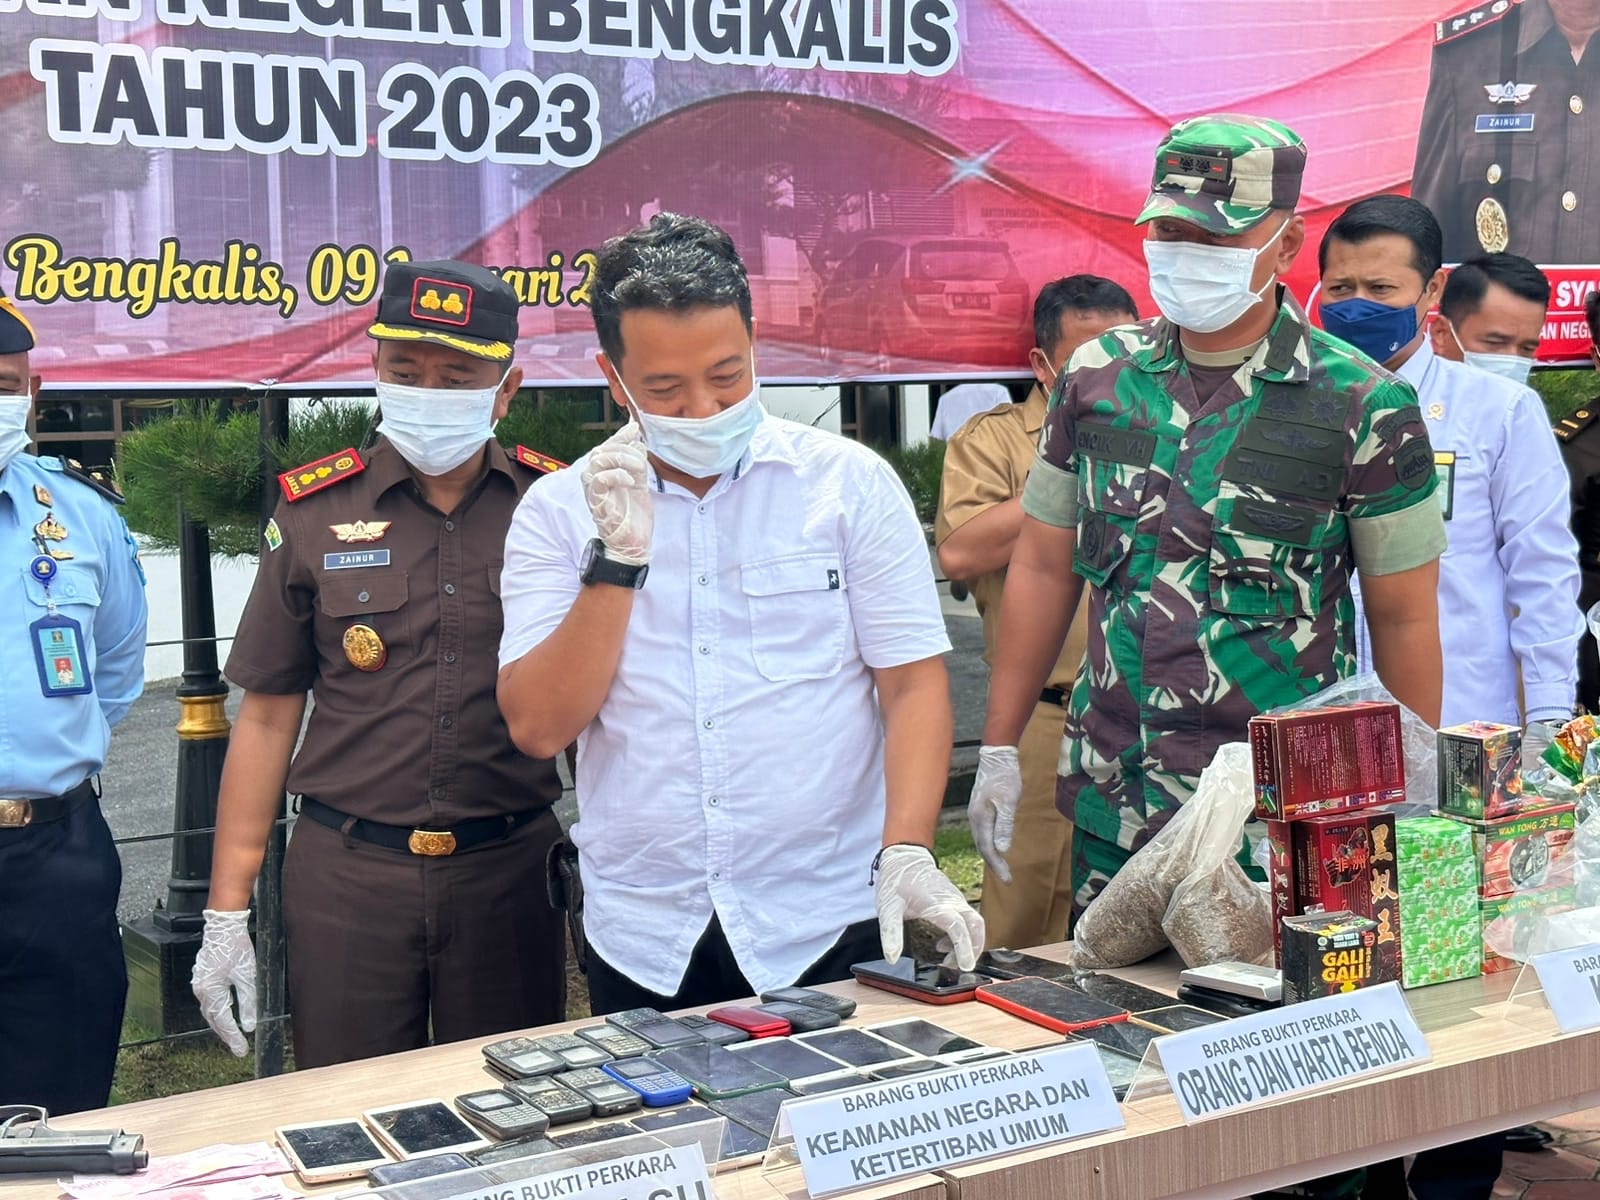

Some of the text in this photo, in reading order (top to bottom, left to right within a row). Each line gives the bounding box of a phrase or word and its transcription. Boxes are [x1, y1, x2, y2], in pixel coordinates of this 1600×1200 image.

[533, 0, 951, 67] BENGKALIS
[42, 50, 592, 157] TAHUN 2023
[1489, 118, 1520, 126] ZAINUR
[7, 237, 295, 315] Bengkalis,
[310, 247, 377, 302] 09
[1560, 321, 1592, 339] NEG
[340, 554, 374, 564] ZAINUR
[1321, 964, 1364, 982] GALI
[1322, 948, 1364, 967] GALI
[1202, 1007, 1362, 1059] BARANG BUKTI PERKARA
[842, 1058, 1044, 1113] BARANG BUKTI PERKARA
[1177, 1019, 1414, 1116] ORANG DAN HARTA BENDA
[806, 1078, 1090, 1158] KEAMANAN NEGARA DAN
[850, 1112, 1070, 1181] KETERTIBAN UMUM
[521, 1153, 677, 1200] BUKTI PERKARA
